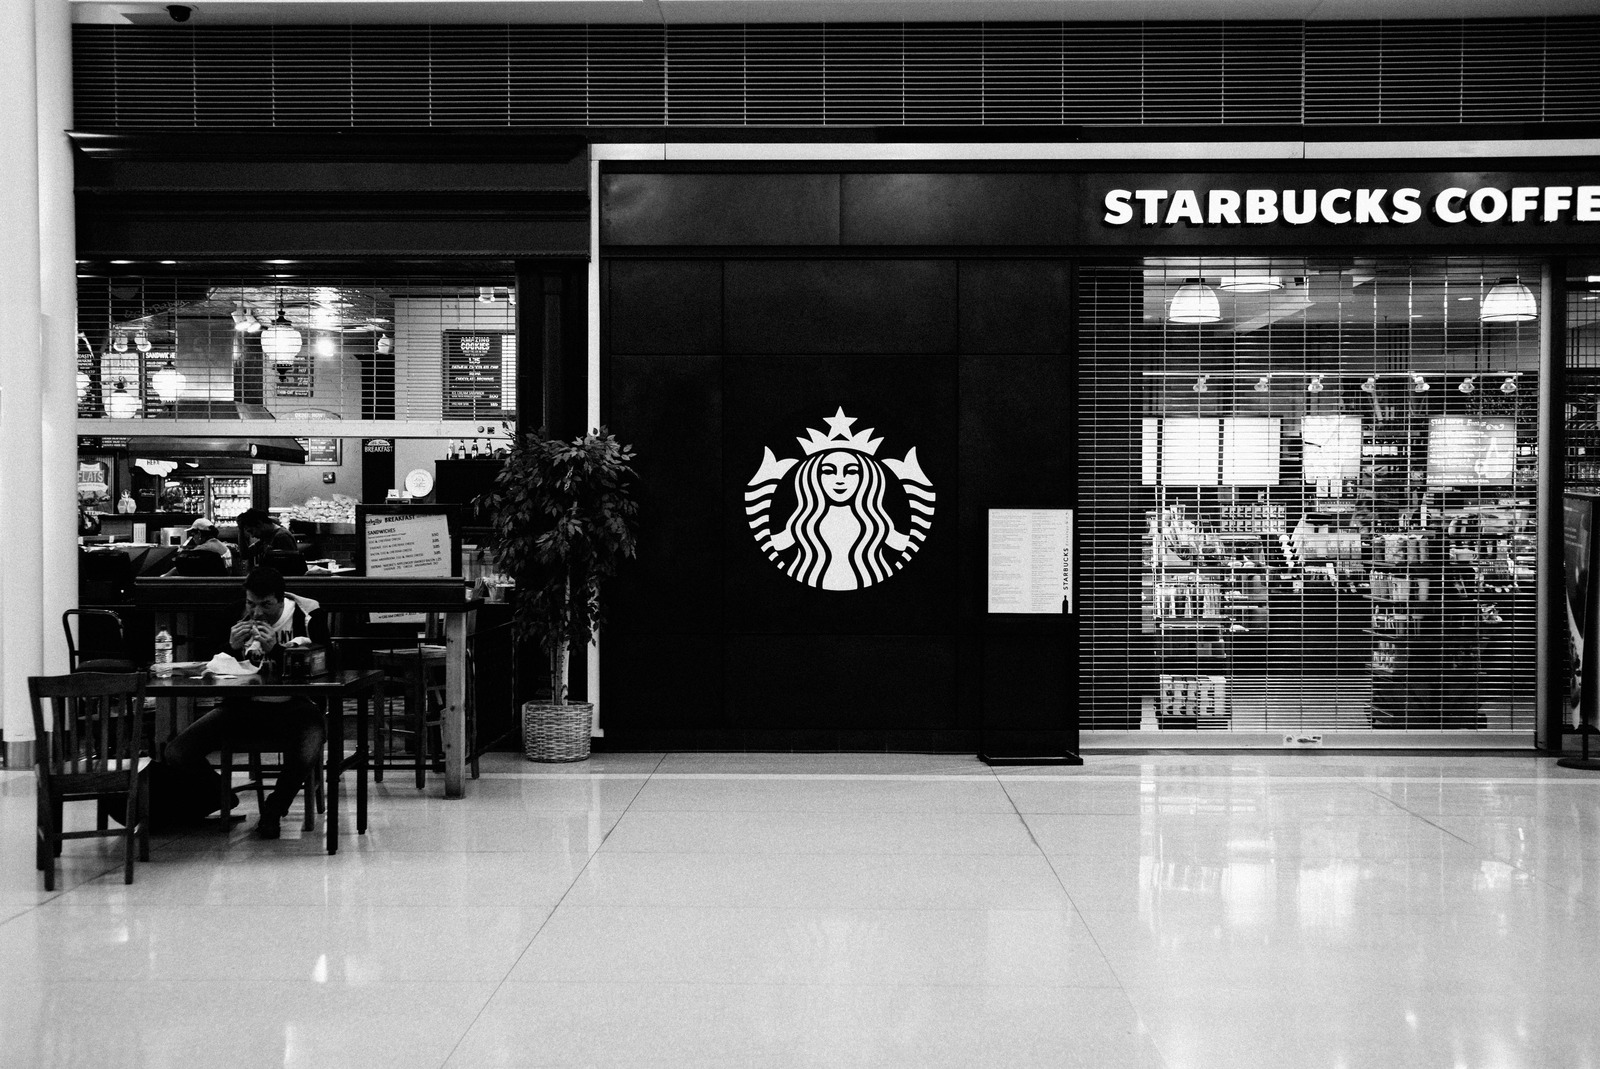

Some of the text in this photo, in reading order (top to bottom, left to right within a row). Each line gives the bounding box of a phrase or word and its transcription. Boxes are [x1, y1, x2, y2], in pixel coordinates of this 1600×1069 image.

[1104, 187, 1421, 226] STARBUCKS
[460, 343, 490, 351] COOKIES
[78, 471, 104, 483] FLATS
[384, 515, 415, 523] BREAKFAST
[367, 528, 396, 536] SANDWICHES
